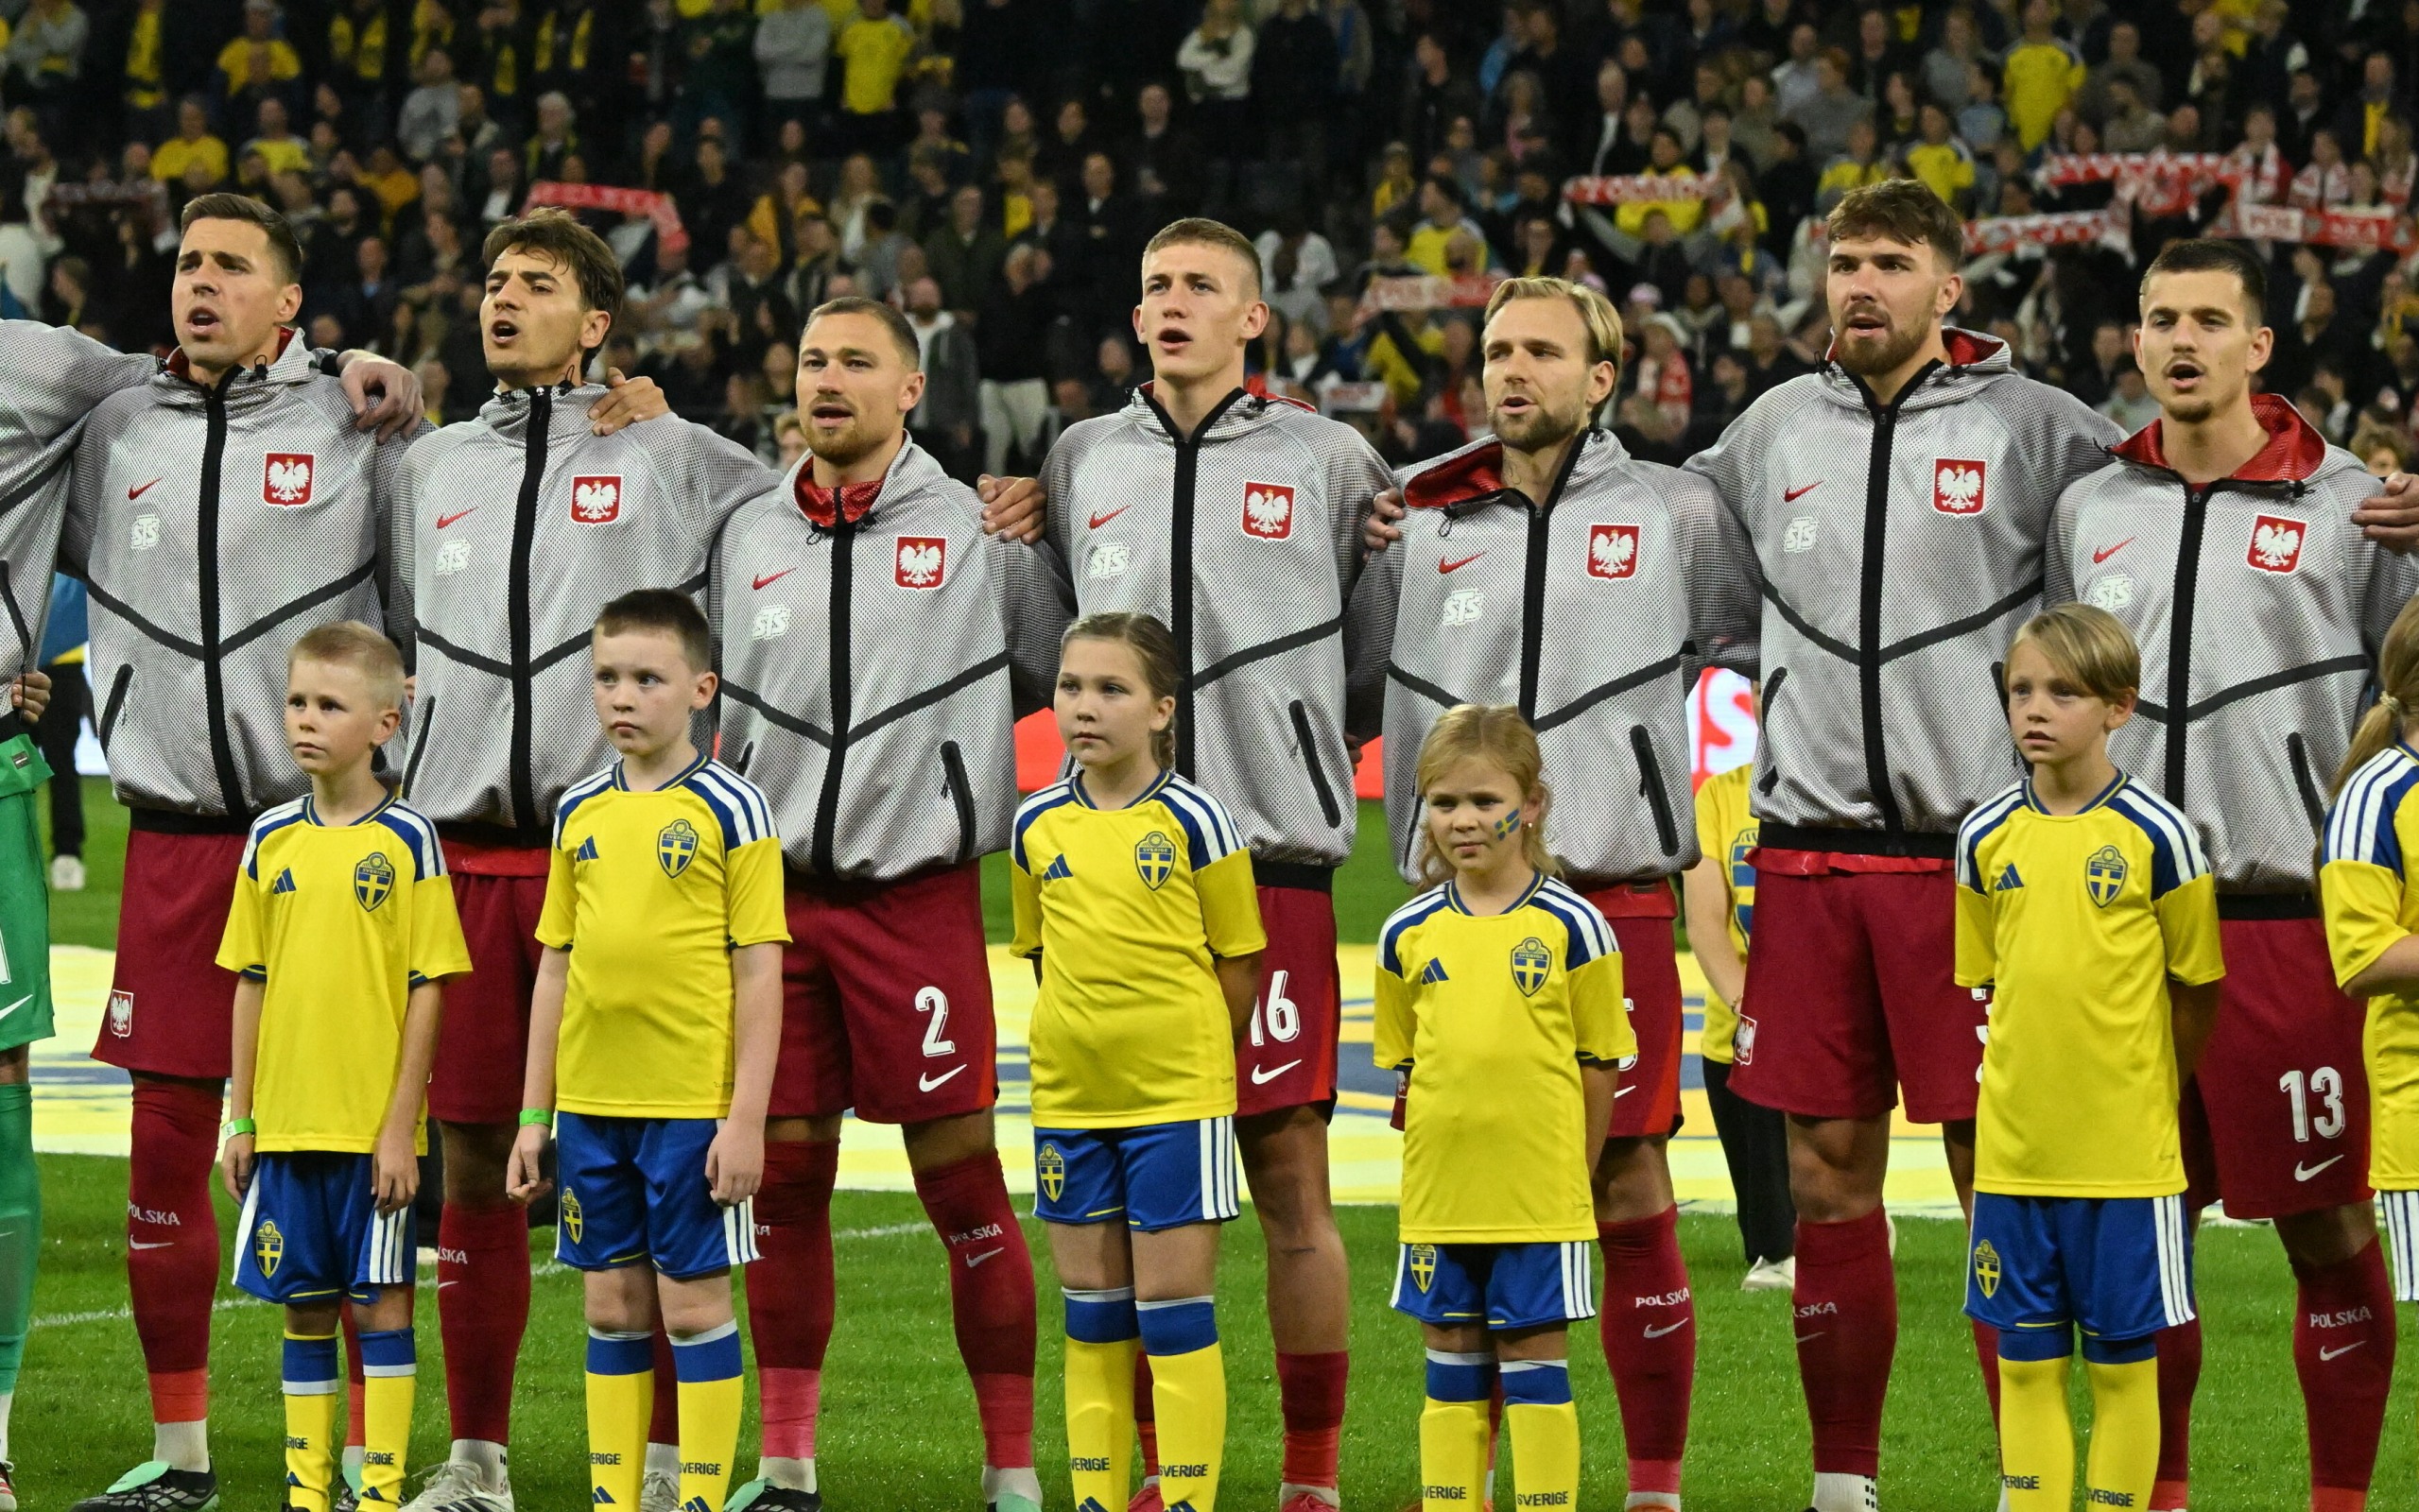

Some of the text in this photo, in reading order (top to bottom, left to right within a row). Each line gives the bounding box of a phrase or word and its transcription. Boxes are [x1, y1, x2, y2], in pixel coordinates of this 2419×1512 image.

[131, 514, 160, 549] STS
[1784, 516, 1820, 553] STS
[436, 540, 471, 576] STS
[1090, 542, 1130, 578] STS
[1443, 590, 1485, 627] STS
[2094, 574, 2133, 611] STS
[752, 604, 791, 640] STS
[914, 986, 956, 1057] 2
[2279, 1066, 2346, 1143] 13
[1635, 1286, 1690, 1309] POLSKA
[2309, 1305, 2373, 1329] POLSKA
[588, 1452, 621, 1466] ERIGE
[1517, 1490, 1568, 1506] SVERIGE
